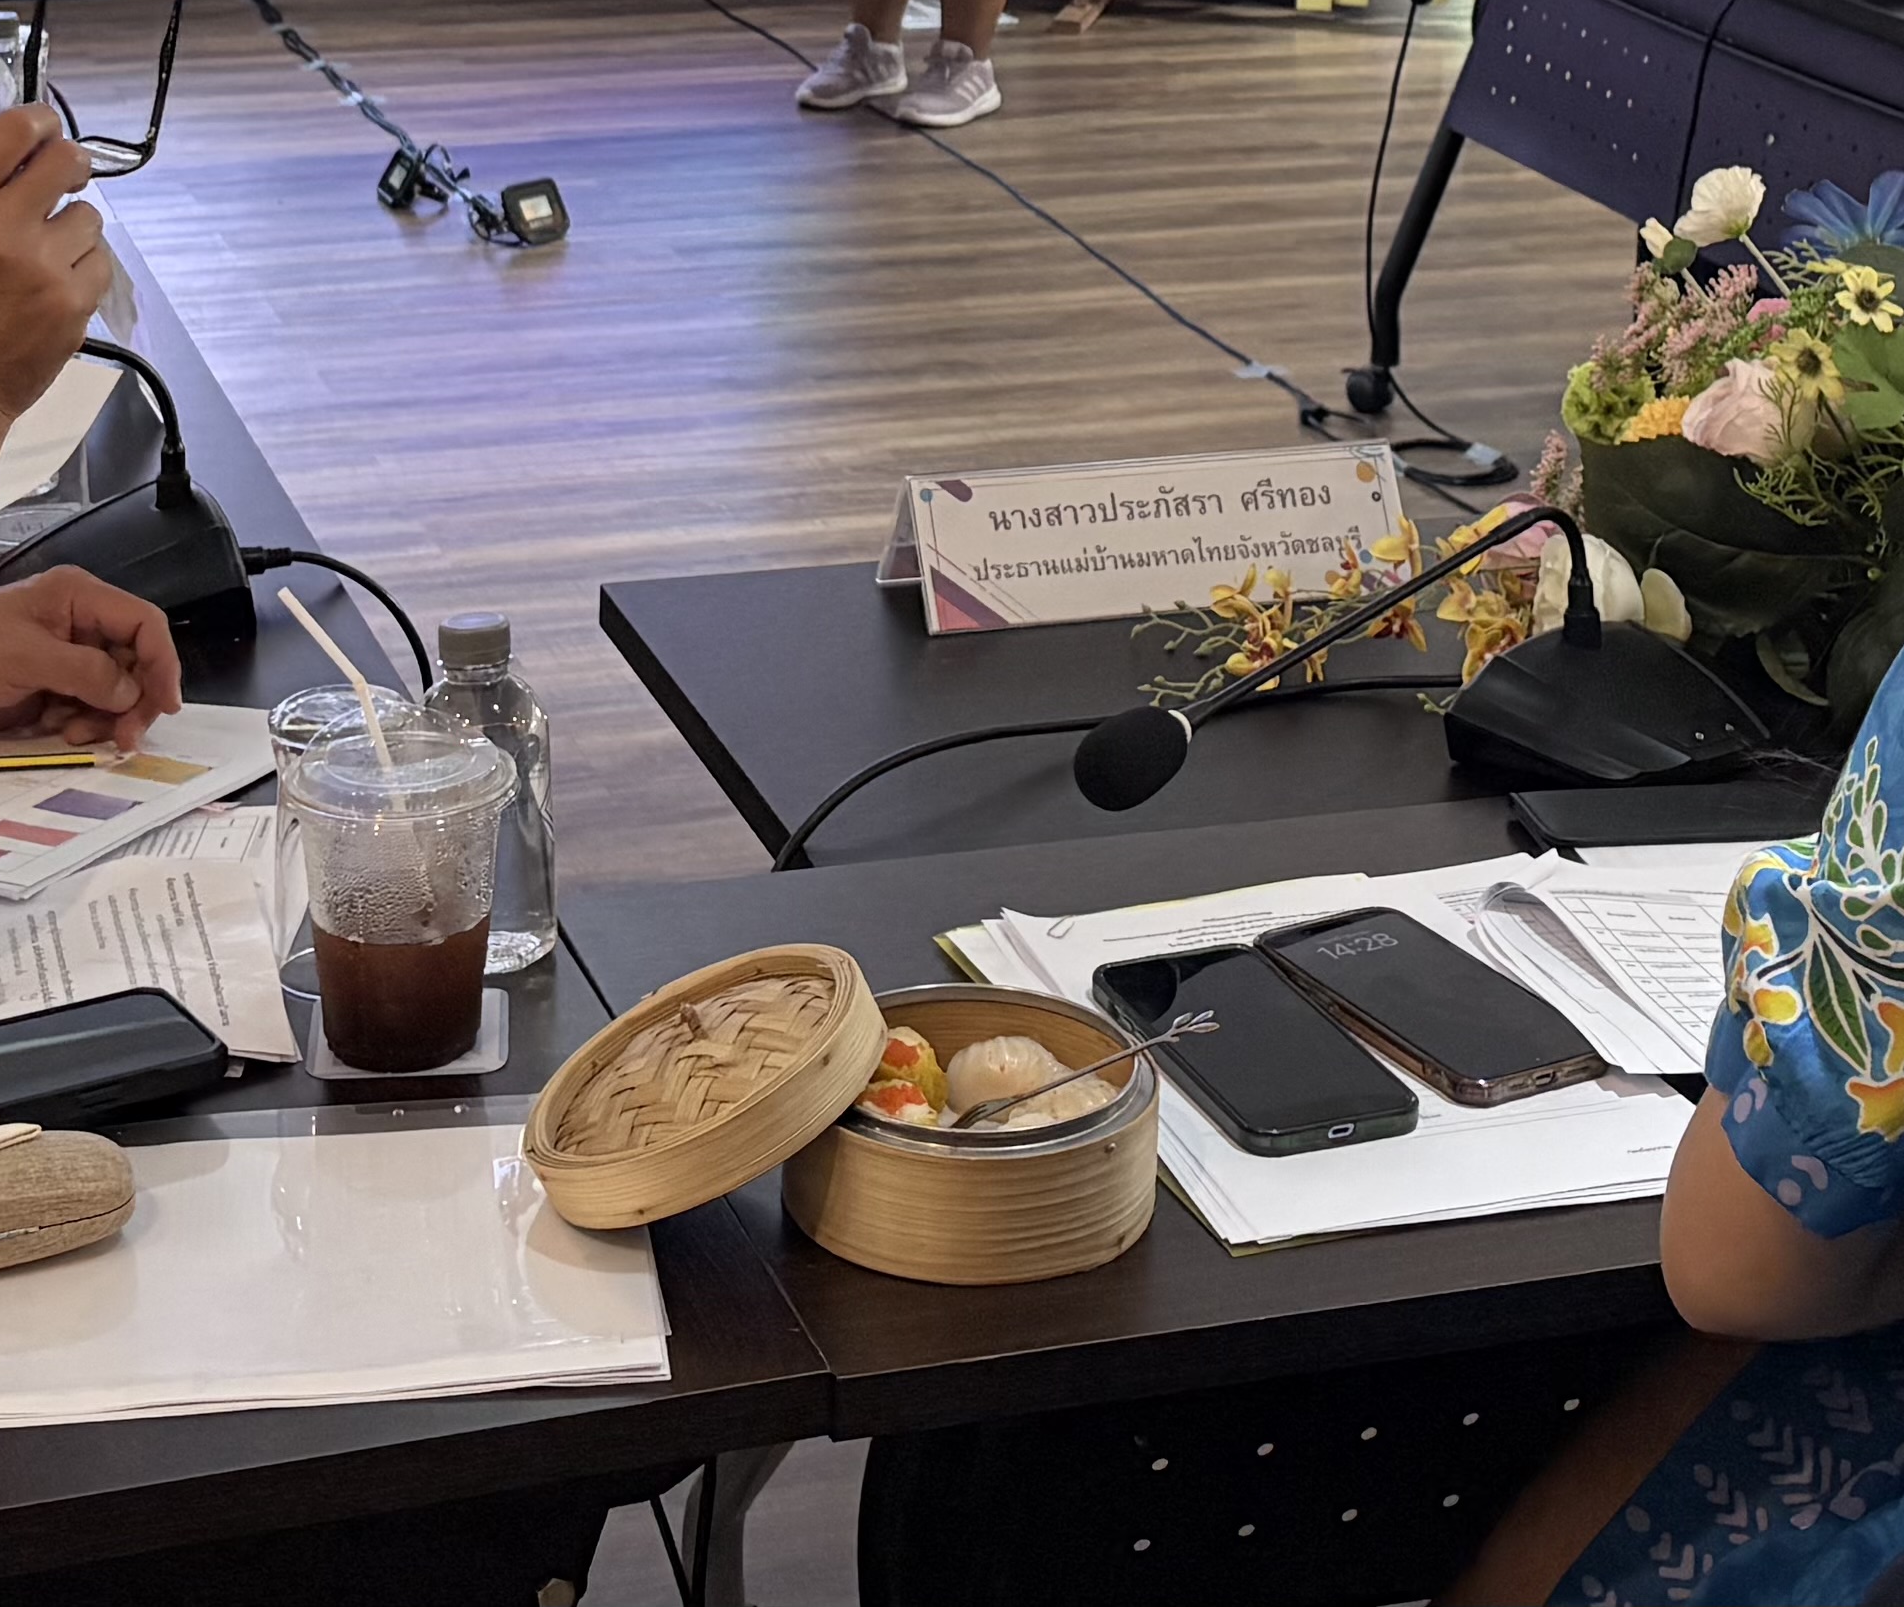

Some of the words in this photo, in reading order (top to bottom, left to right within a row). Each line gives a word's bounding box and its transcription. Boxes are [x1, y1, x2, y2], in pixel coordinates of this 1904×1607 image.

[988, 485, 1224, 532] นางสาวประภัสรา
[1240, 477, 1332, 512] ศรีทอง
[1316, 932, 1399, 961] 14:28
